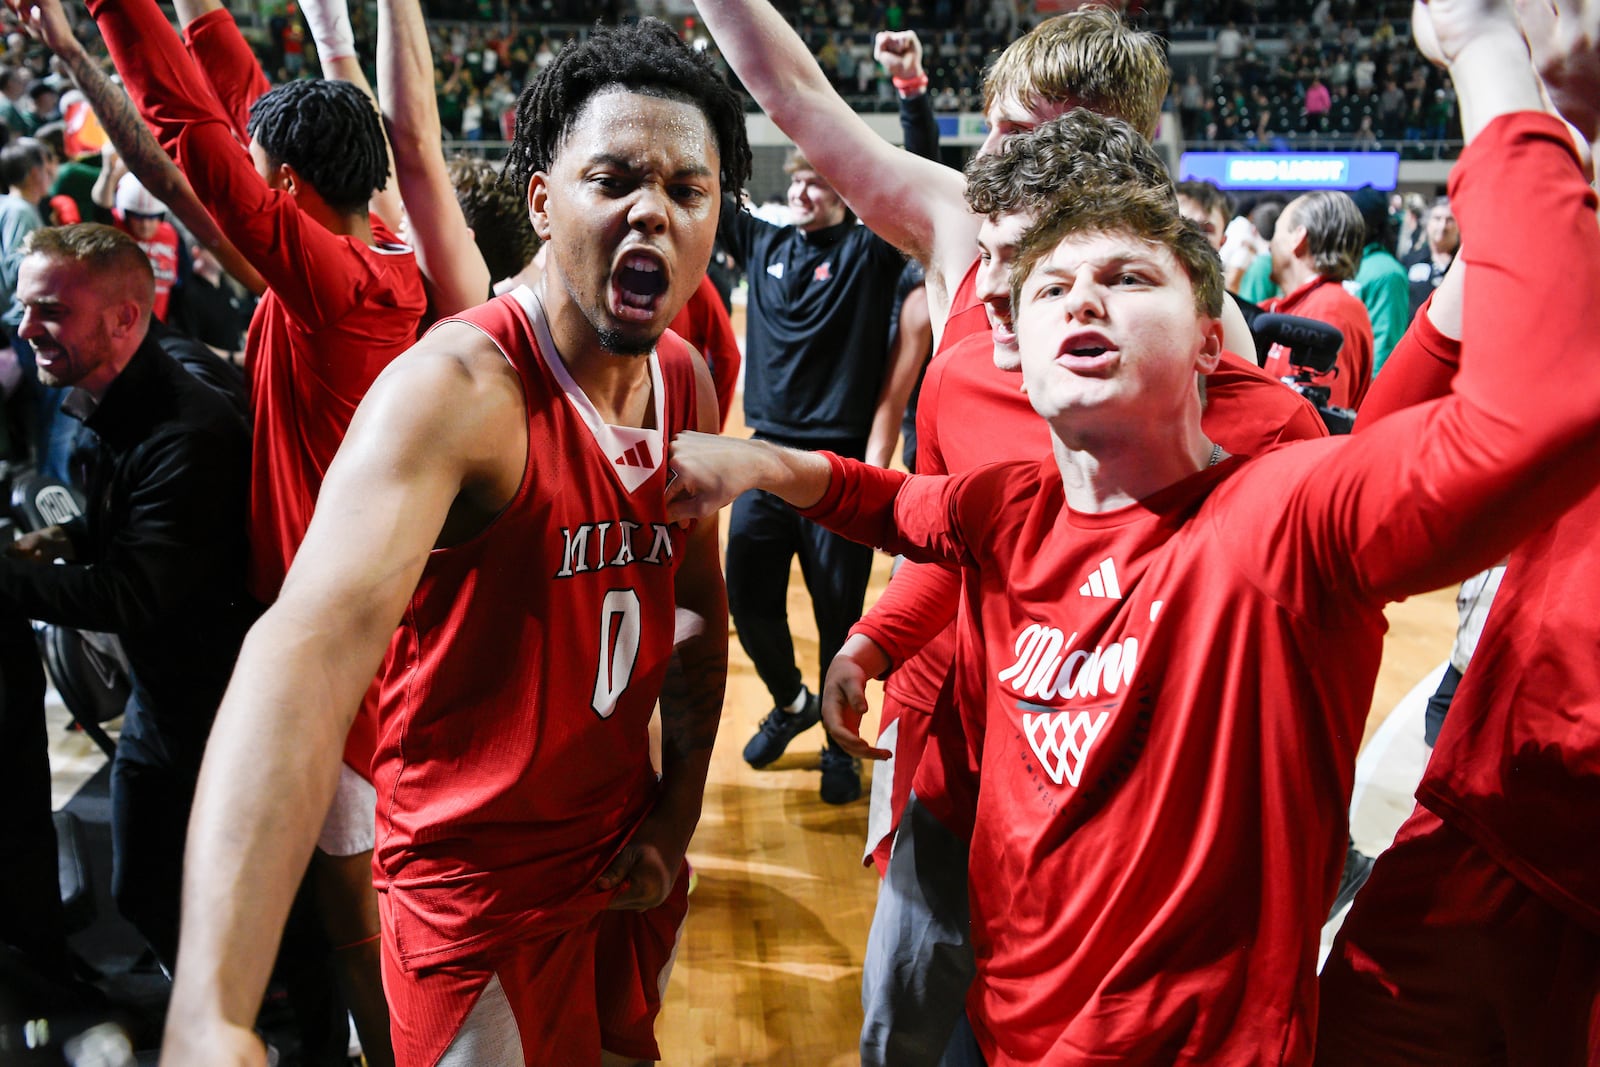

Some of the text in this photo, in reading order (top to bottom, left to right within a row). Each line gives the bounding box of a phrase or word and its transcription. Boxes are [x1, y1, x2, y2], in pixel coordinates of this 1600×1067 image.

[1230, 160, 1344, 180] BUD LIGHT
[553, 520, 672, 579] MIAM
[591, 587, 641, 719] 0
[998, 600, 1164, 700] Miam
